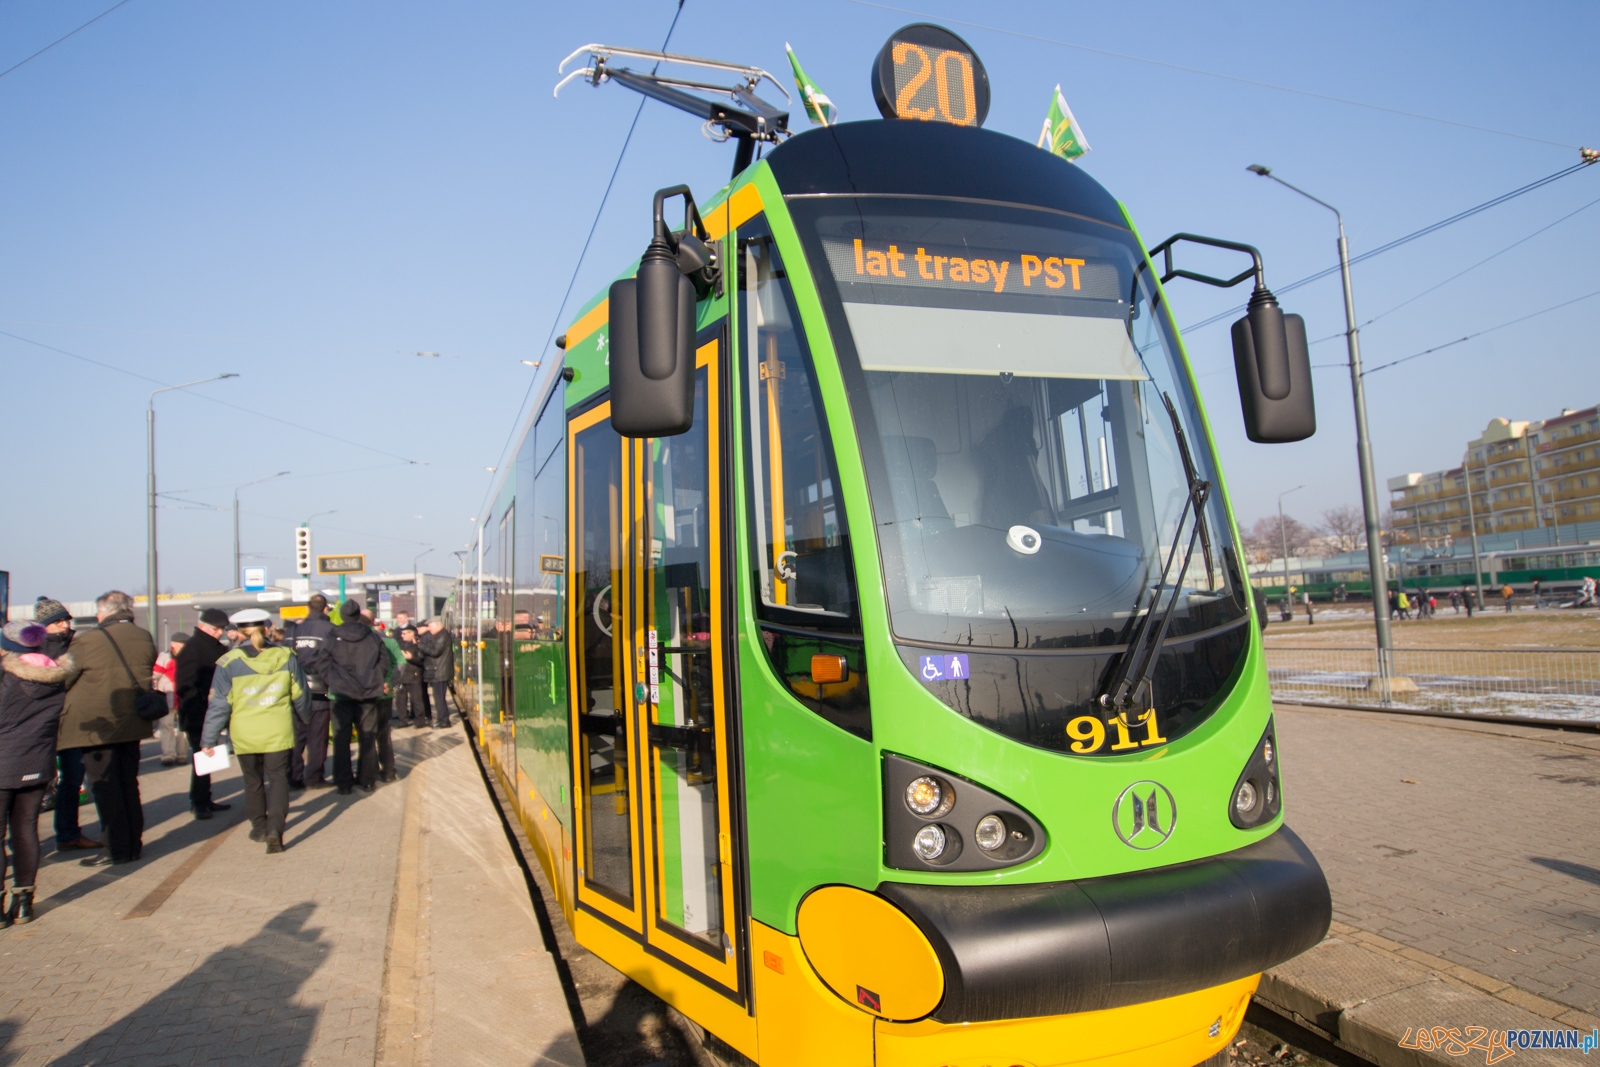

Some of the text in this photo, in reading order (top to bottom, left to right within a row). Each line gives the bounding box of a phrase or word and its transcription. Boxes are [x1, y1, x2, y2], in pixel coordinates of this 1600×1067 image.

[892, 42, 977, 126] 20
[853, 238, 1086, 293] lat trasy PST
[325, 559, 359, 568] 12:46
[295, 640, 316, 649] MPS
[1065, 708, 1167, 754] 911
